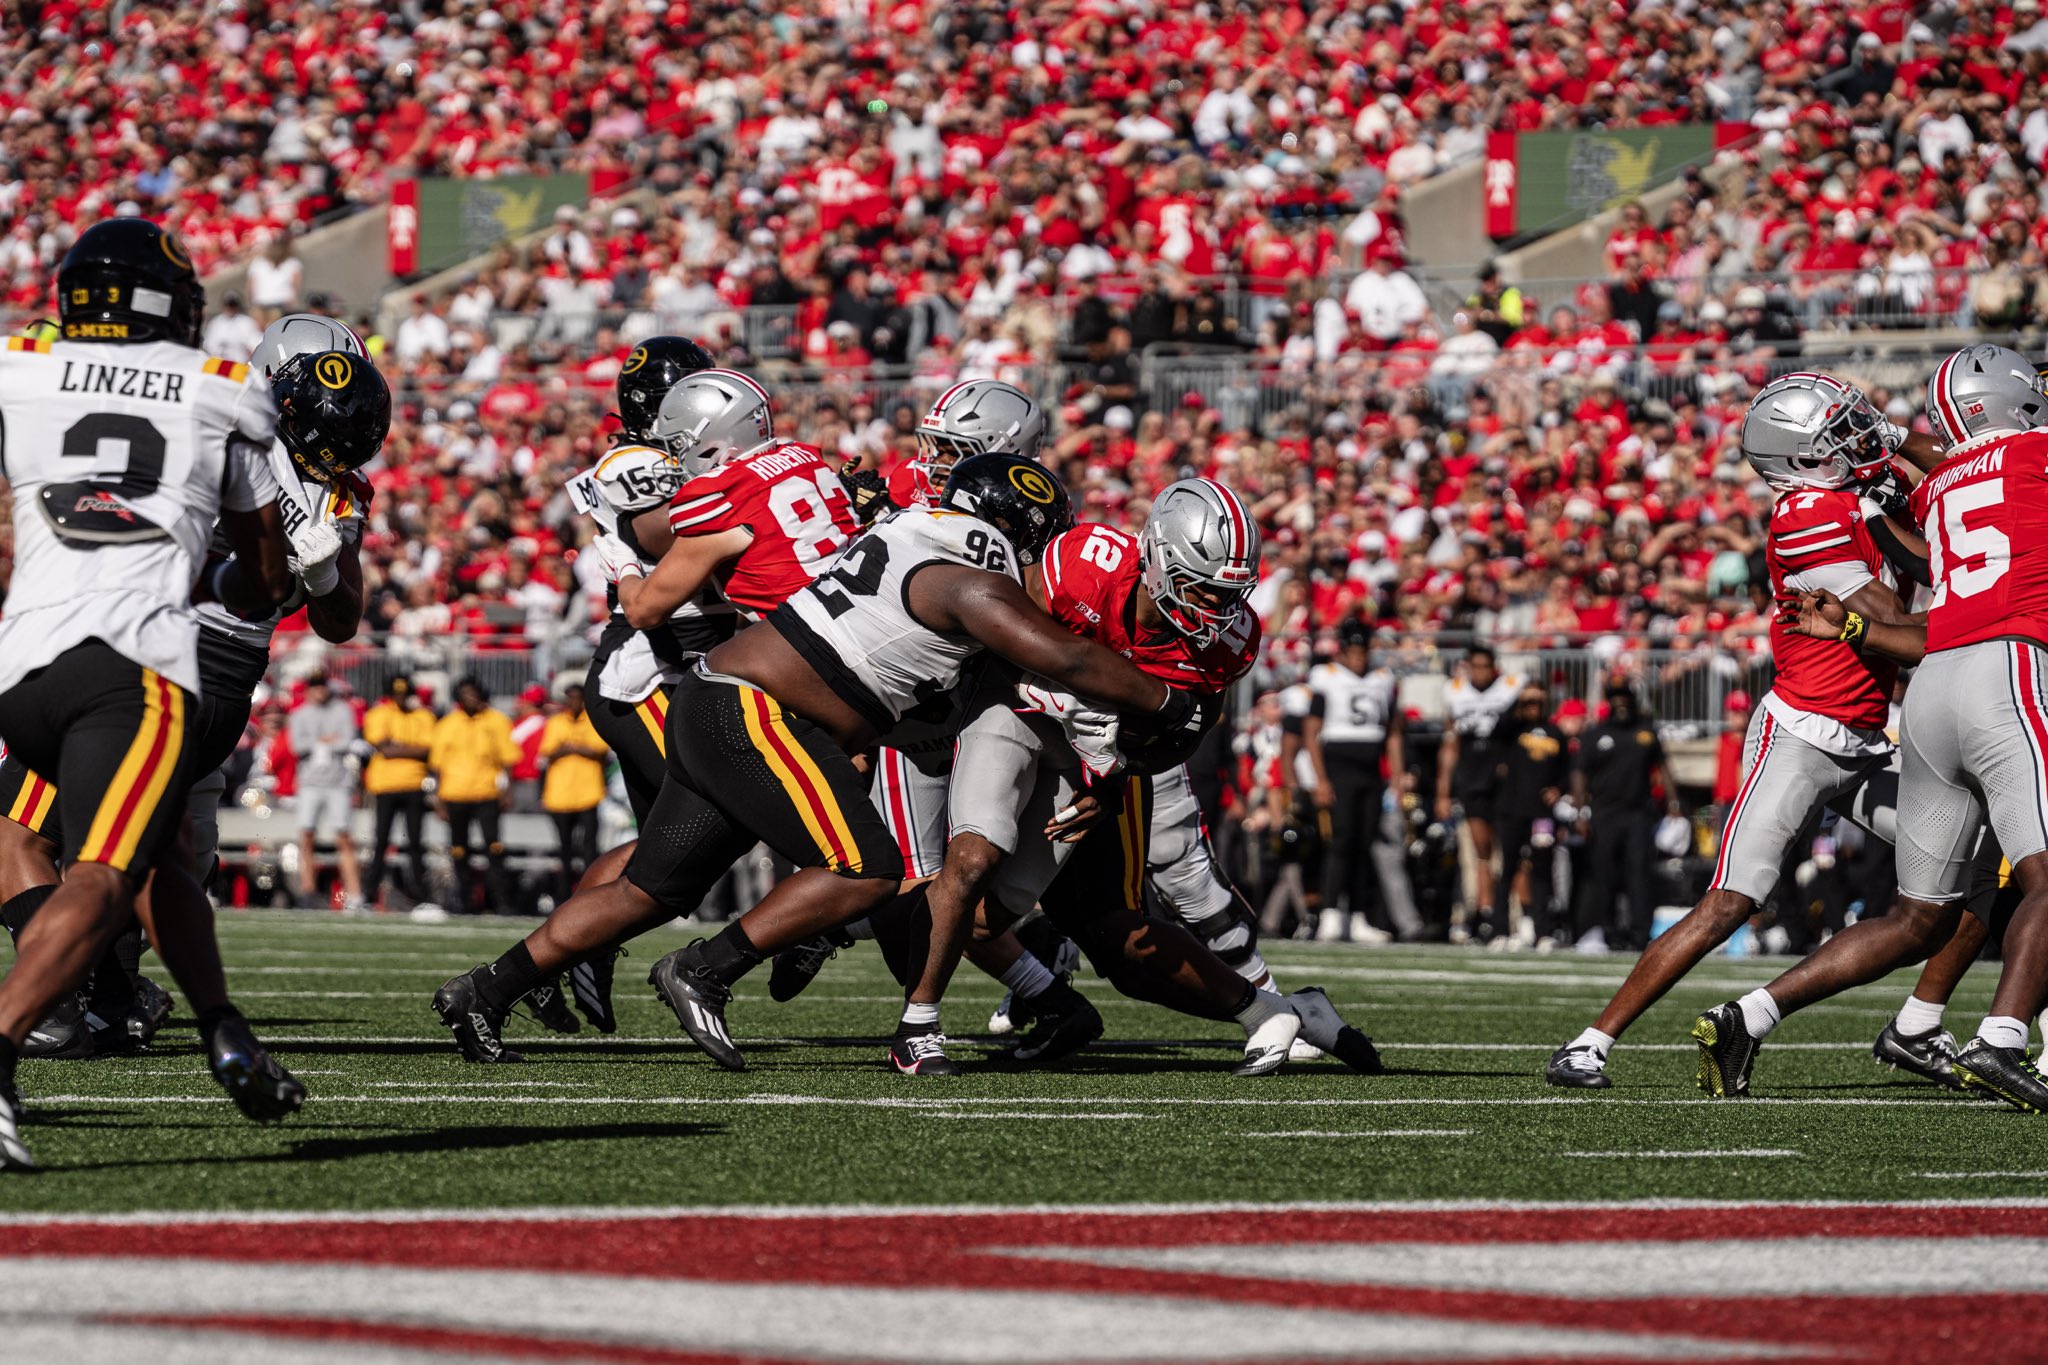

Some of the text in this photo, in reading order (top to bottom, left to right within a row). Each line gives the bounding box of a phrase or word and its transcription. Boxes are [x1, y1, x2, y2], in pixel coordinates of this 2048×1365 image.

[107, 287, 121, 304] 3
[65, 323, 129, 338] G-MEN
[60, 361, 184, 402] LINZER
[746, 446, 818, 481] ROBERTS
[1927, 445, 2008, 506] THURMAN
[616, 466, 656, 503] 15
[963, 529, 1006, 572] 92
[1080, 525, 1129, 573] 12
[1925, 477, 2011, 612] 15
